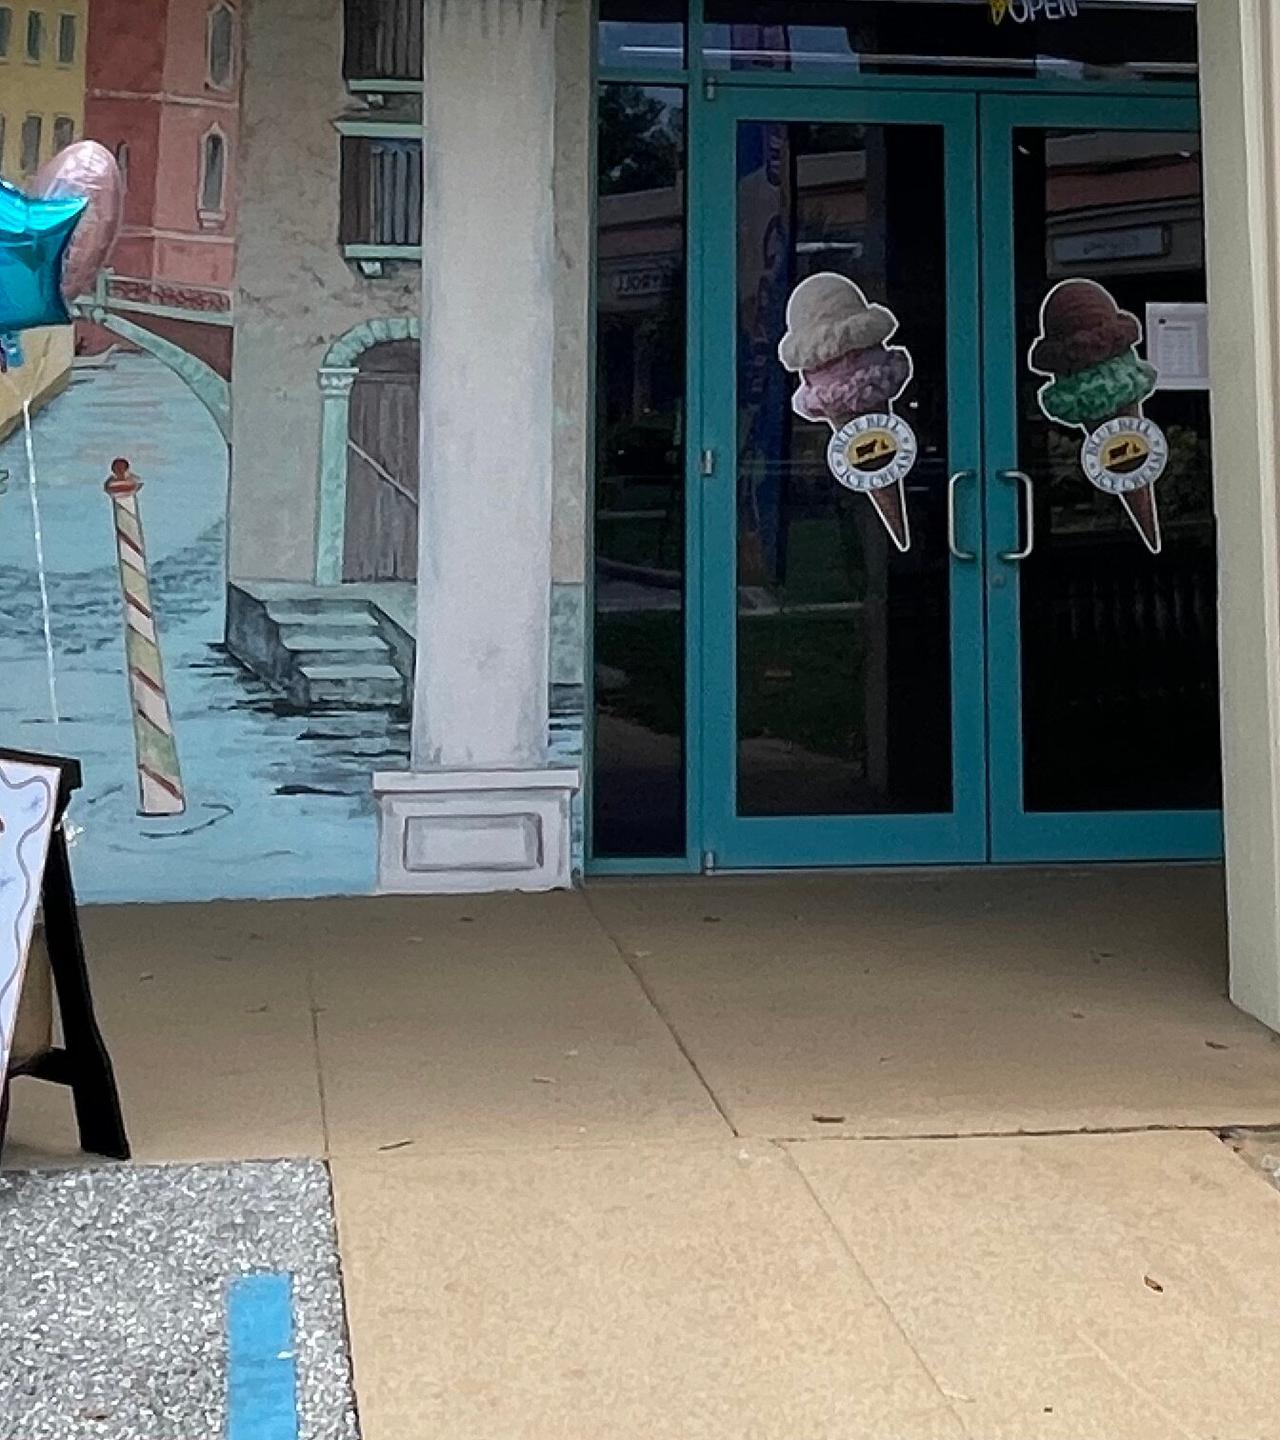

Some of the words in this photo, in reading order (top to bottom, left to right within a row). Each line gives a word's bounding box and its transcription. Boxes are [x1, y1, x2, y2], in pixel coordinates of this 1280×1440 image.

[831, 421, 862, 453] BLUE
[865, 415, 899, 431] BELL
[1086, 424, 1116, 456] BLUE
[1118, 419, 1150, 434] BELL
[835, 466, 863, 487] ICE
[868, 448, 911, 487] CREAM
